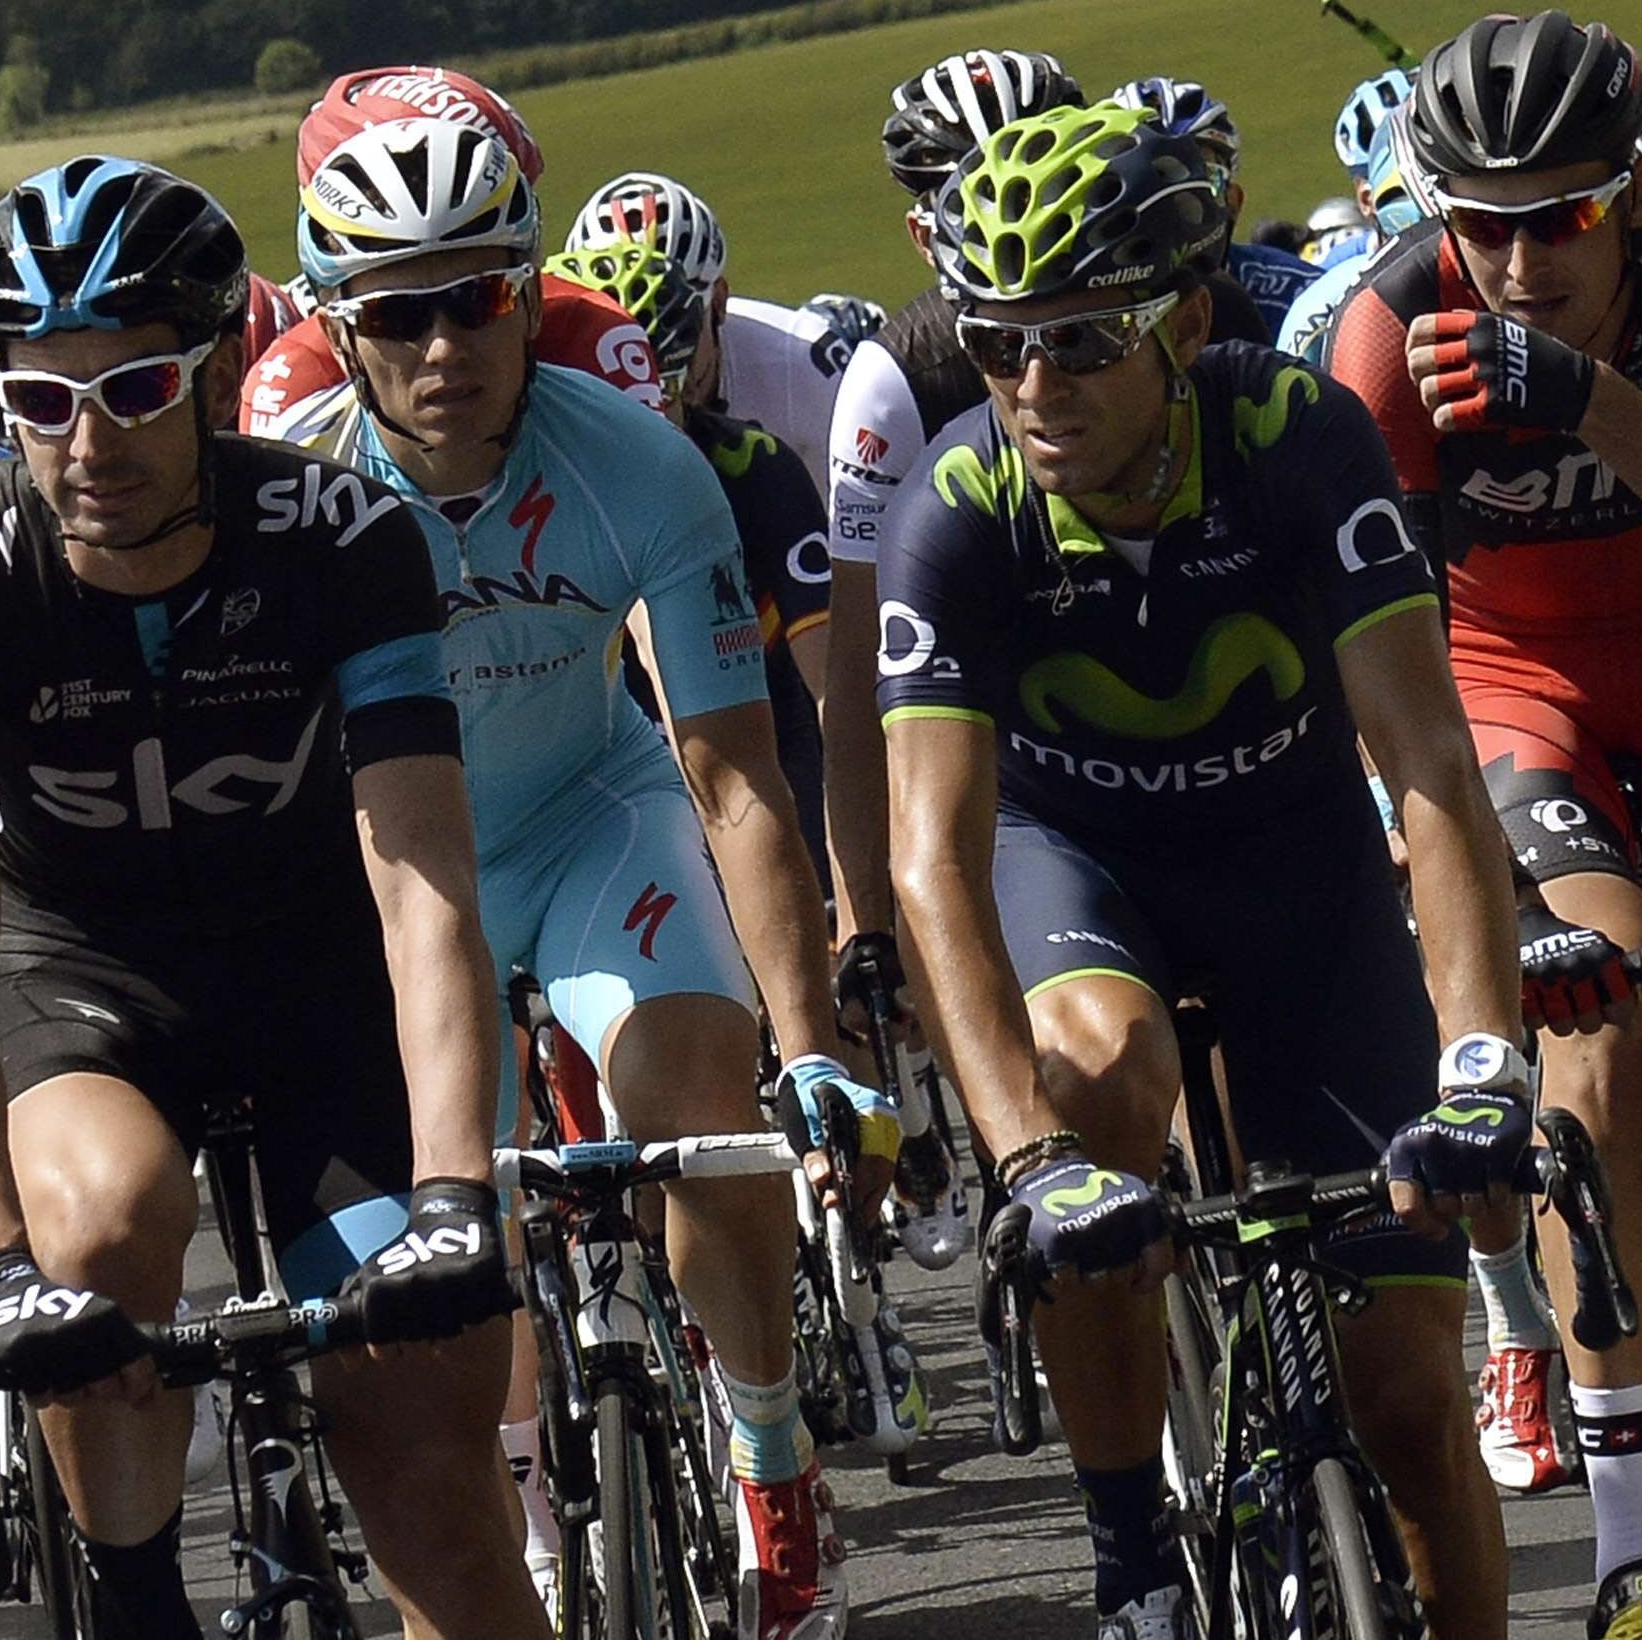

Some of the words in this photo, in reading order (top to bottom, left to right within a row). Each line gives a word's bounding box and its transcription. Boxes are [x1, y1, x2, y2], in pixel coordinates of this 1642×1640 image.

[1088, 263, 1155, 289] catlike
[1504, 319, 1529, 408] BMC
[257, 464, 401, 546] sky
[28, 702, 326, 831] sky
[1010, 706, 1318, 793] movistar
[377, 1222, 481, 1276] sky
[1057, 1190, 1140, 1234] movistar
